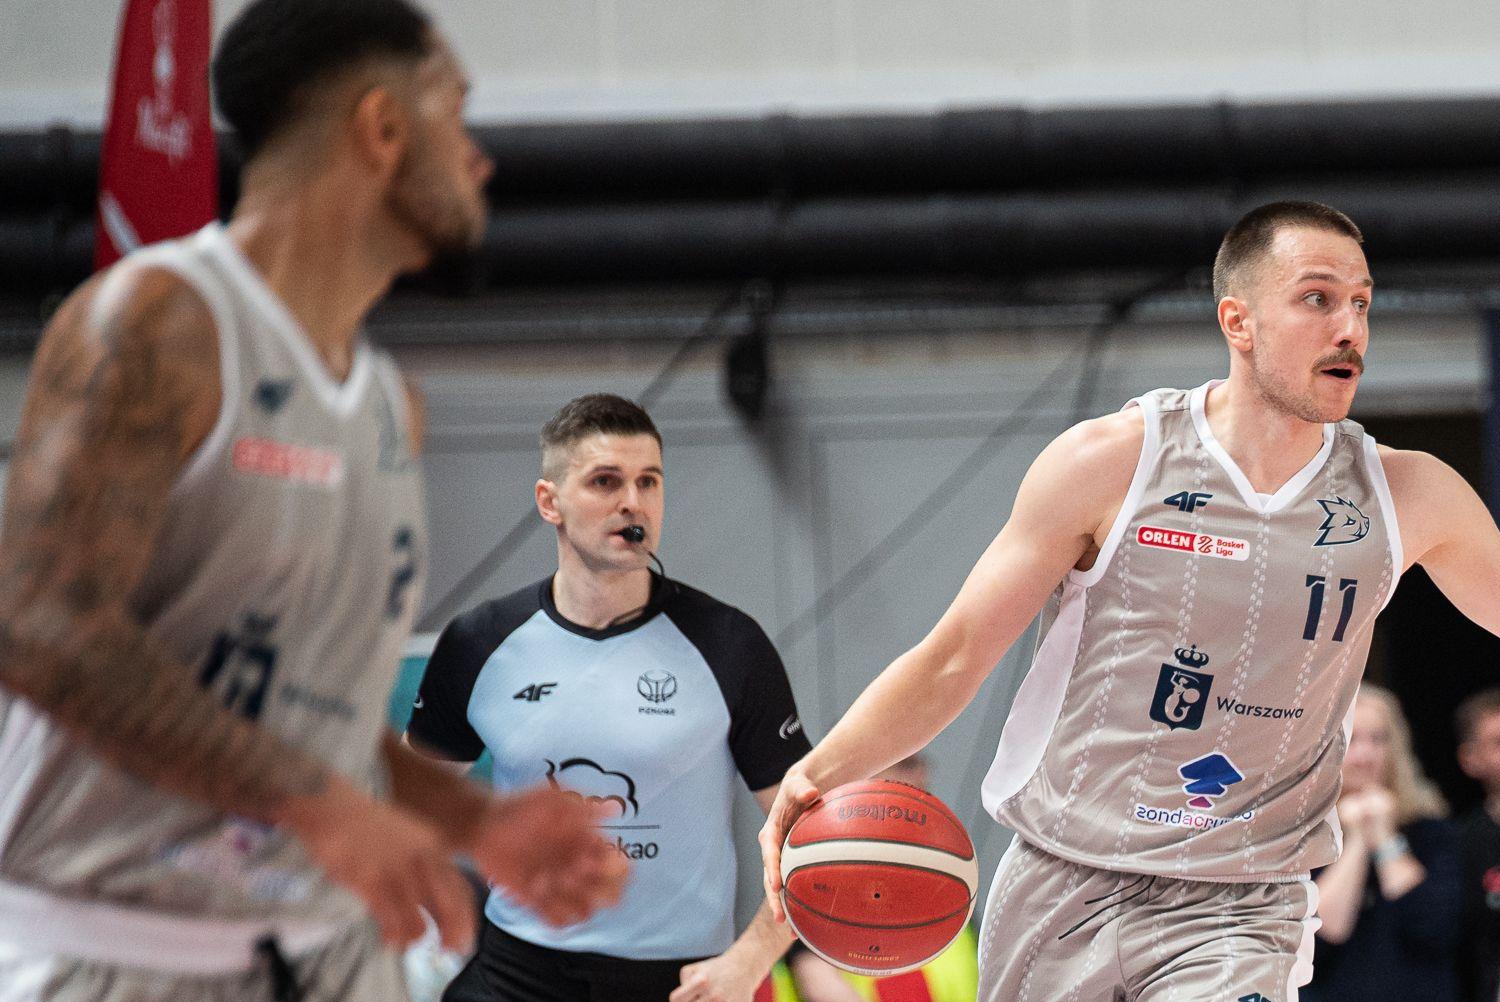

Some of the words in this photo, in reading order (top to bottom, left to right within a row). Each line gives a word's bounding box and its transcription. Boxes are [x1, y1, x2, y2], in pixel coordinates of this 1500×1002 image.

[1163, 490, 1214, 513] 4F
[1141, 530, 1190, 548] ORLEN
[1216, 538, 1244, 550] Basket
[1216, 548, 1233, 556] Liga
[1302, 574, 1358, 642] 11
[513, 682, 558, 701] 4F
[1216, 696, 1304, 719] Warszawa
[838, 804, 928, 826] molten
[613, 833, 659, 860] kao
